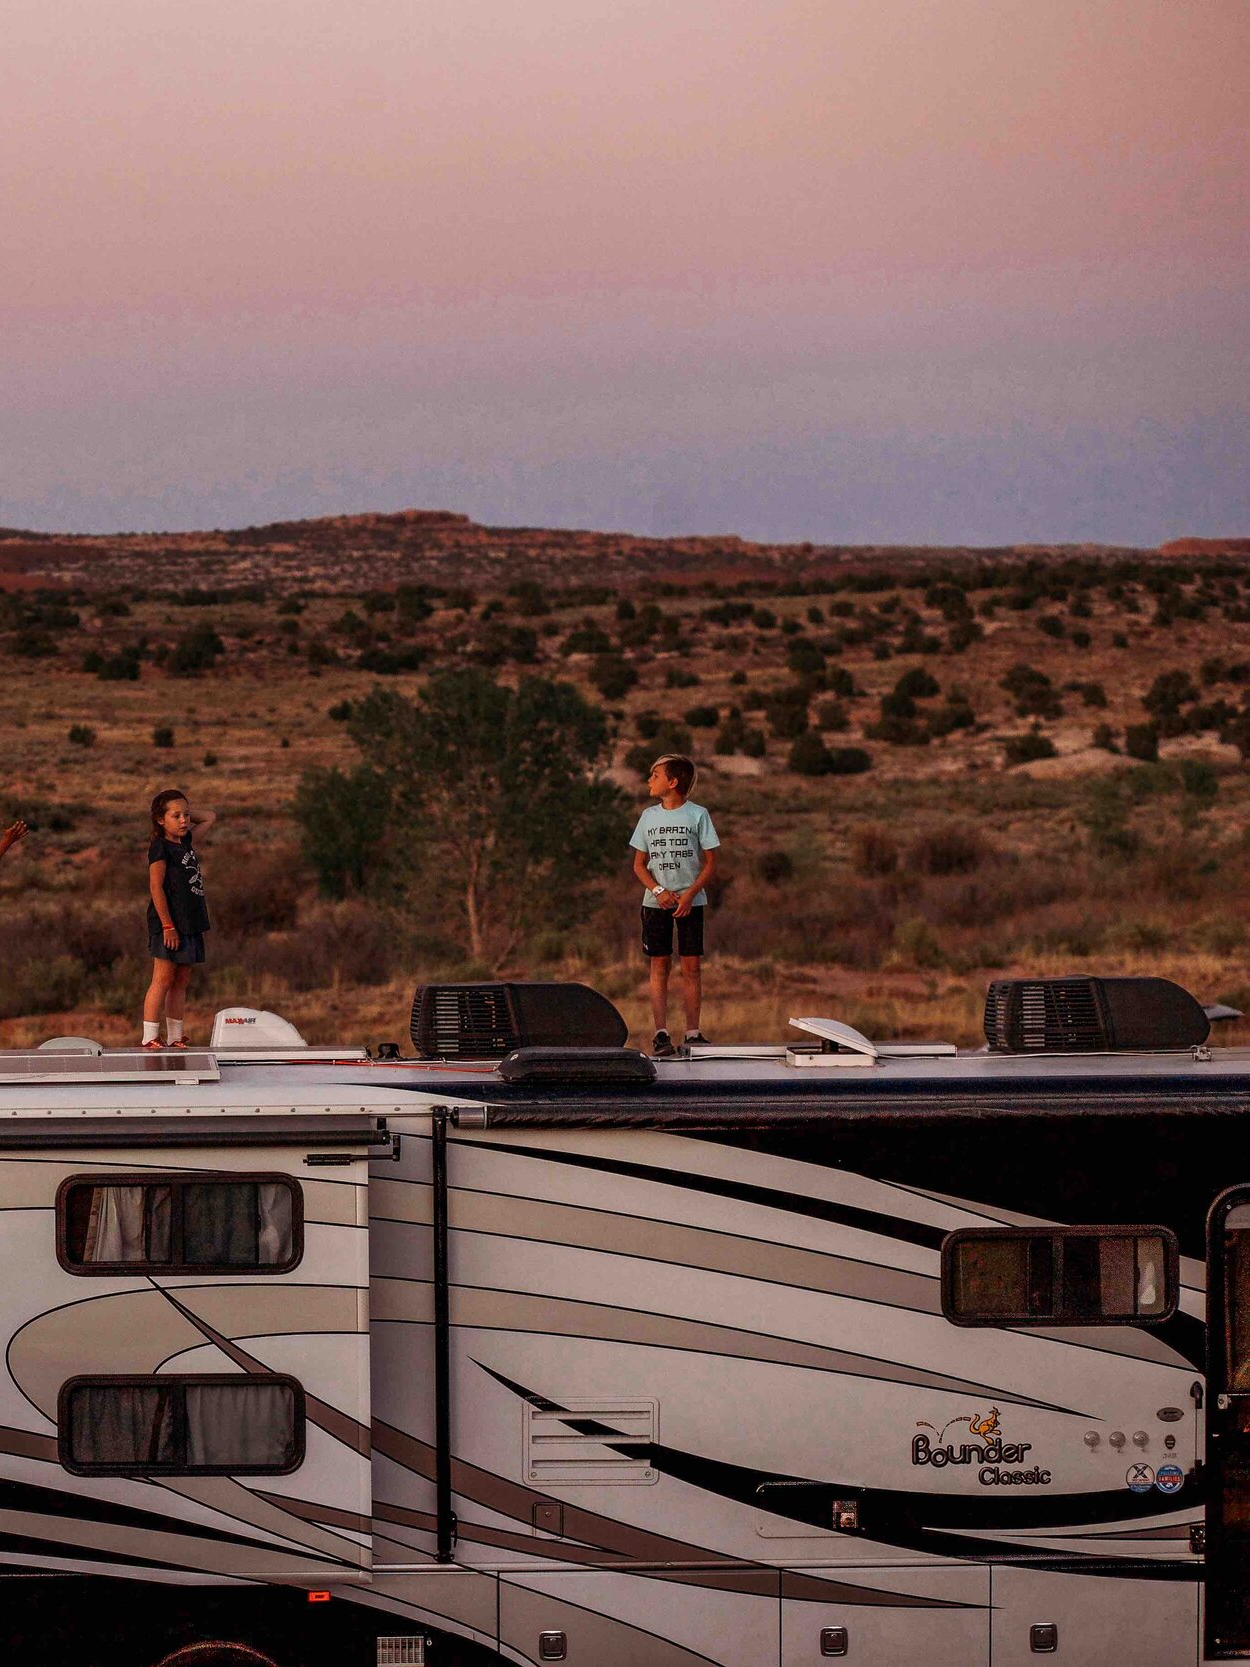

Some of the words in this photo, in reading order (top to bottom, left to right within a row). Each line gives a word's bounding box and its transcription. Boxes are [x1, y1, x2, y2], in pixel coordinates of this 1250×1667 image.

[647, 827, 658, 836] MY
[659, 826, 692, 835] BRAIN
[669, 838, 688, 846] TOO
[669, 849, 694, 858] TABS
[658, 862, 681, 871] OPEN
[912, 1434, 1032, 1468] Bounder
[978, 1466, 1052, 1486] Classic
